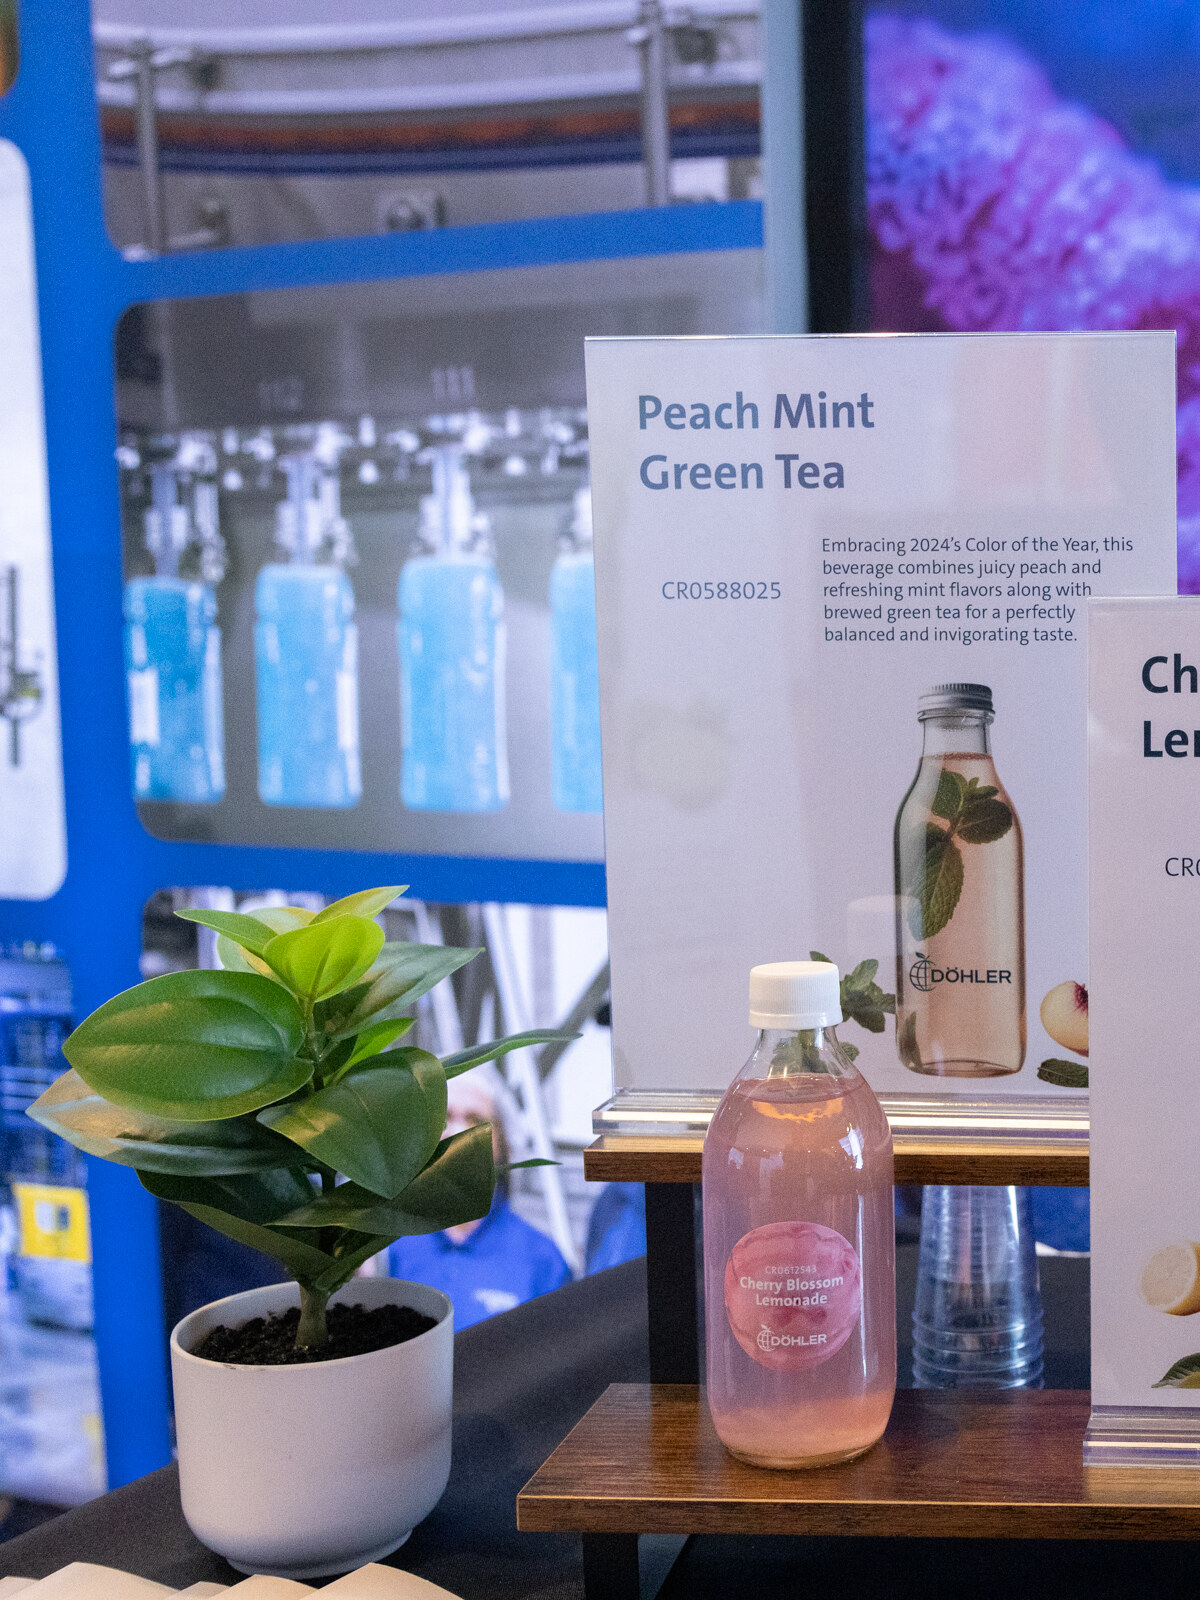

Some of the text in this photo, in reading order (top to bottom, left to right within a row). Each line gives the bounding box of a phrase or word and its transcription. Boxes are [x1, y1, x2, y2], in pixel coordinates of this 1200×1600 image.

[638, 390, 875, 431] Peach Mint
[639, 453, 845, 491] Green Tea
[822, 536, 907, 557] Embracing
[965, 536, 1008, 552] Color
[1010, 535, 1029, 552] of
[1031, 536, 1059, 552] the
[1061, 537, 1100, 554] Year,
[1102, 536, 1134, 552] this
[822, 558, 1102, 580] beverage combines juicy peach and
[661, 581, 782, 600] CR0588025
[823, 581, 1092, 602] refreshing mint flavors along with
[823, 603, 1076, 624] brewed green tea for a perfectly
[824, 626, 1078, 647] balanced and invigorating taste.
[930, 965, 1013, 985] DÖHLER
[739, 1275, 844, 1295] Cherry Blossom
[755, 1292, 828, 1307] Lemonade
[770, 1333, 827, 1346] DÖHLER
